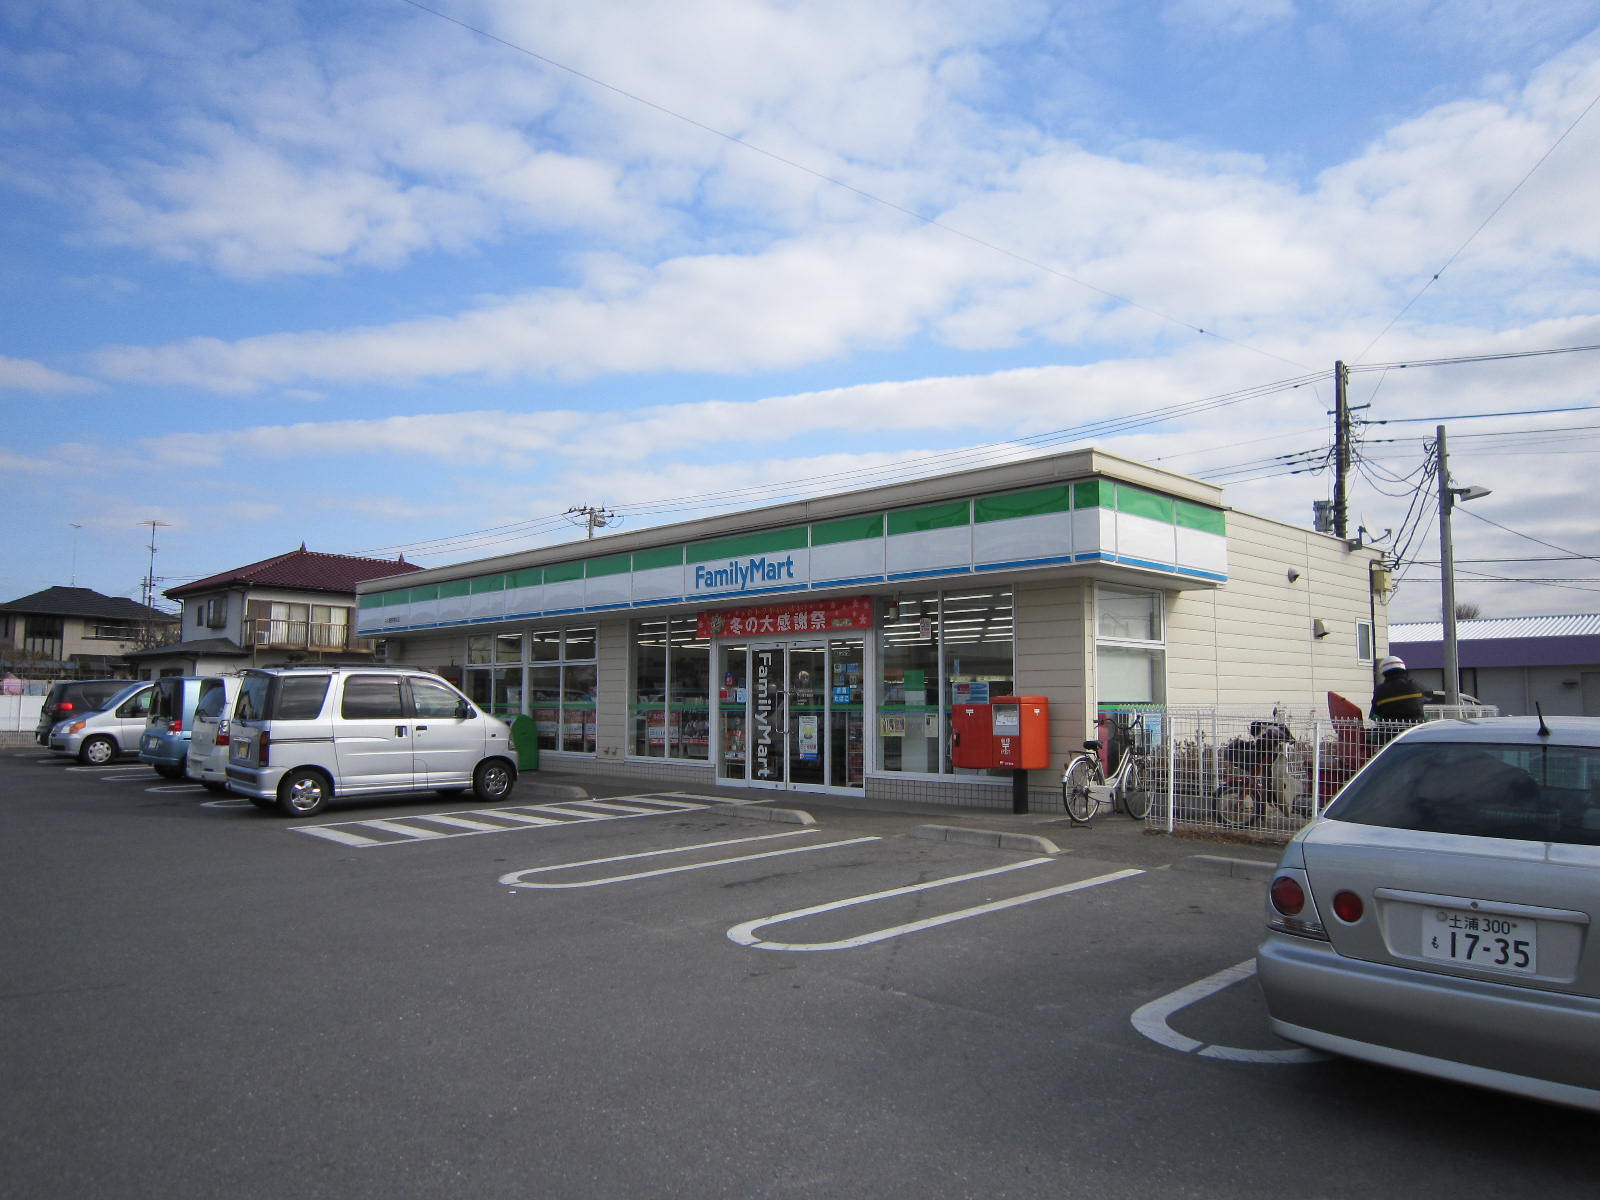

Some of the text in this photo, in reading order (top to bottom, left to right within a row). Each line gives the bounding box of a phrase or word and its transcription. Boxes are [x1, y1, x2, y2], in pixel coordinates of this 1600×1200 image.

[695, 556, 794, 590] FamilyMart
[730, 610, 826, 635] 冬の大感謝祭
[755, 652, 772, 777] FamilyMart
[1448, 914, 1511, 935] 土浦 300
[1450, 931, 1530, 968] 17-35
